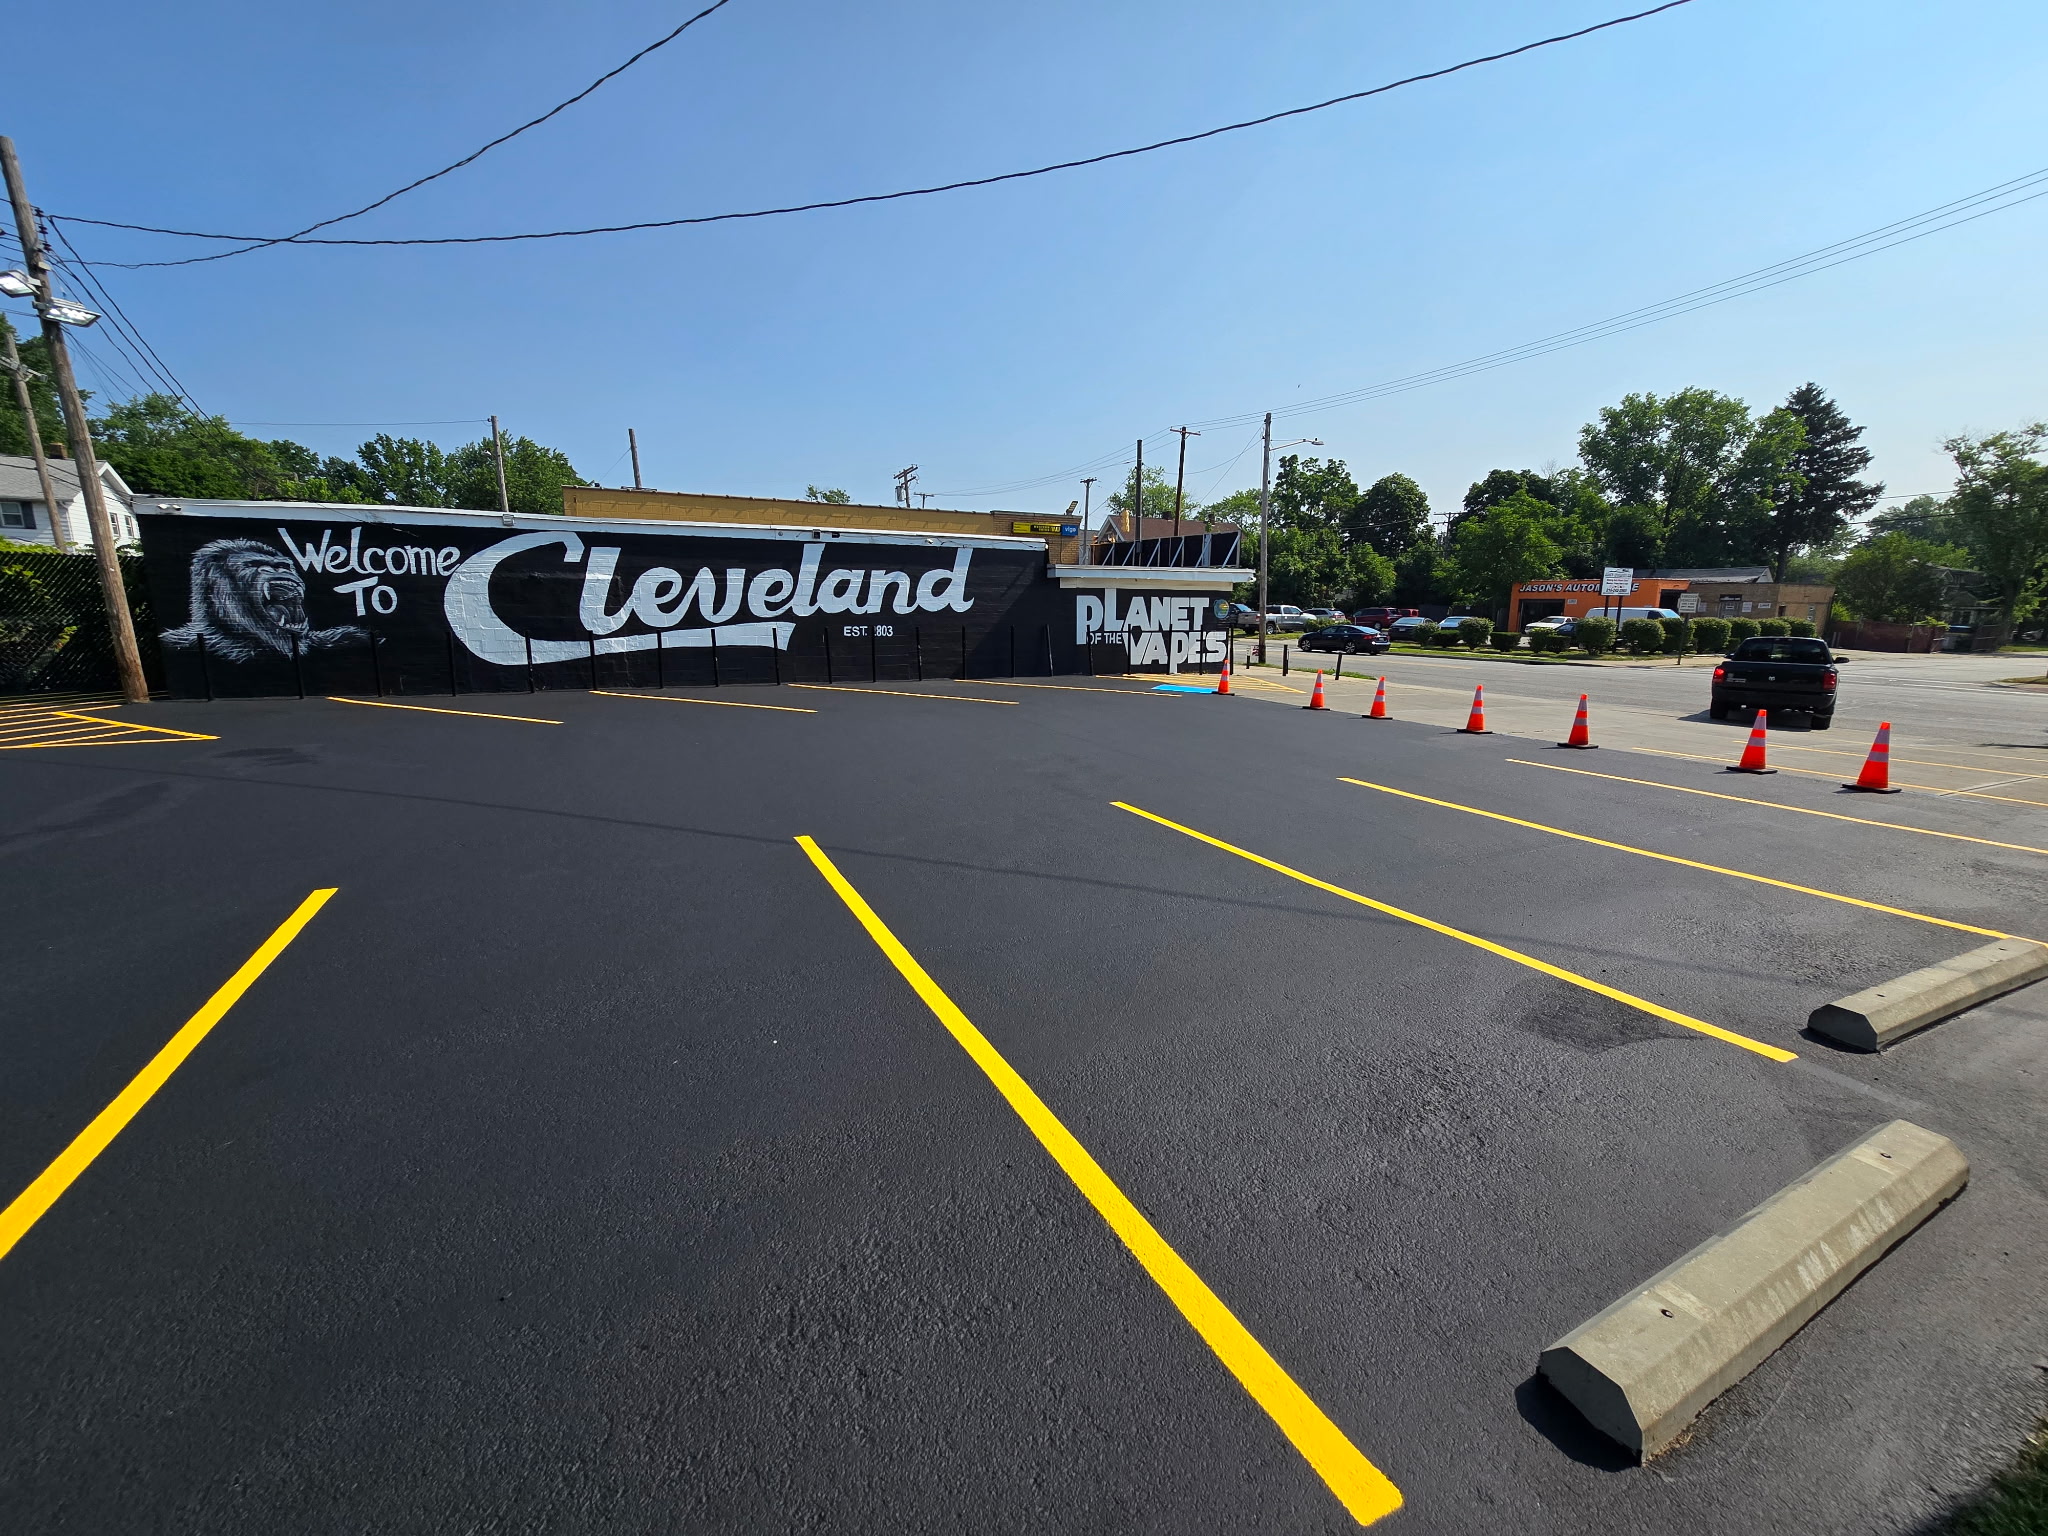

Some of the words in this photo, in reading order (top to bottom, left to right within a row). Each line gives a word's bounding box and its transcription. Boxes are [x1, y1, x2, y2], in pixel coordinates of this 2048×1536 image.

[277, 526, 462, 577] Welcome
[333, 575, 398, 617] To
[443, 530, 975, 666] Cleveland
[1519, 583, 1563, 593] JASON'S
[843, 625, 868, 637] EST.
[1076, 587, 1210, 645] PLANET
[1087, 632, 1102, 645] OF
[1103, 632, 1123, 645] THE
[1122, 631, 1227, 674] VAPES
